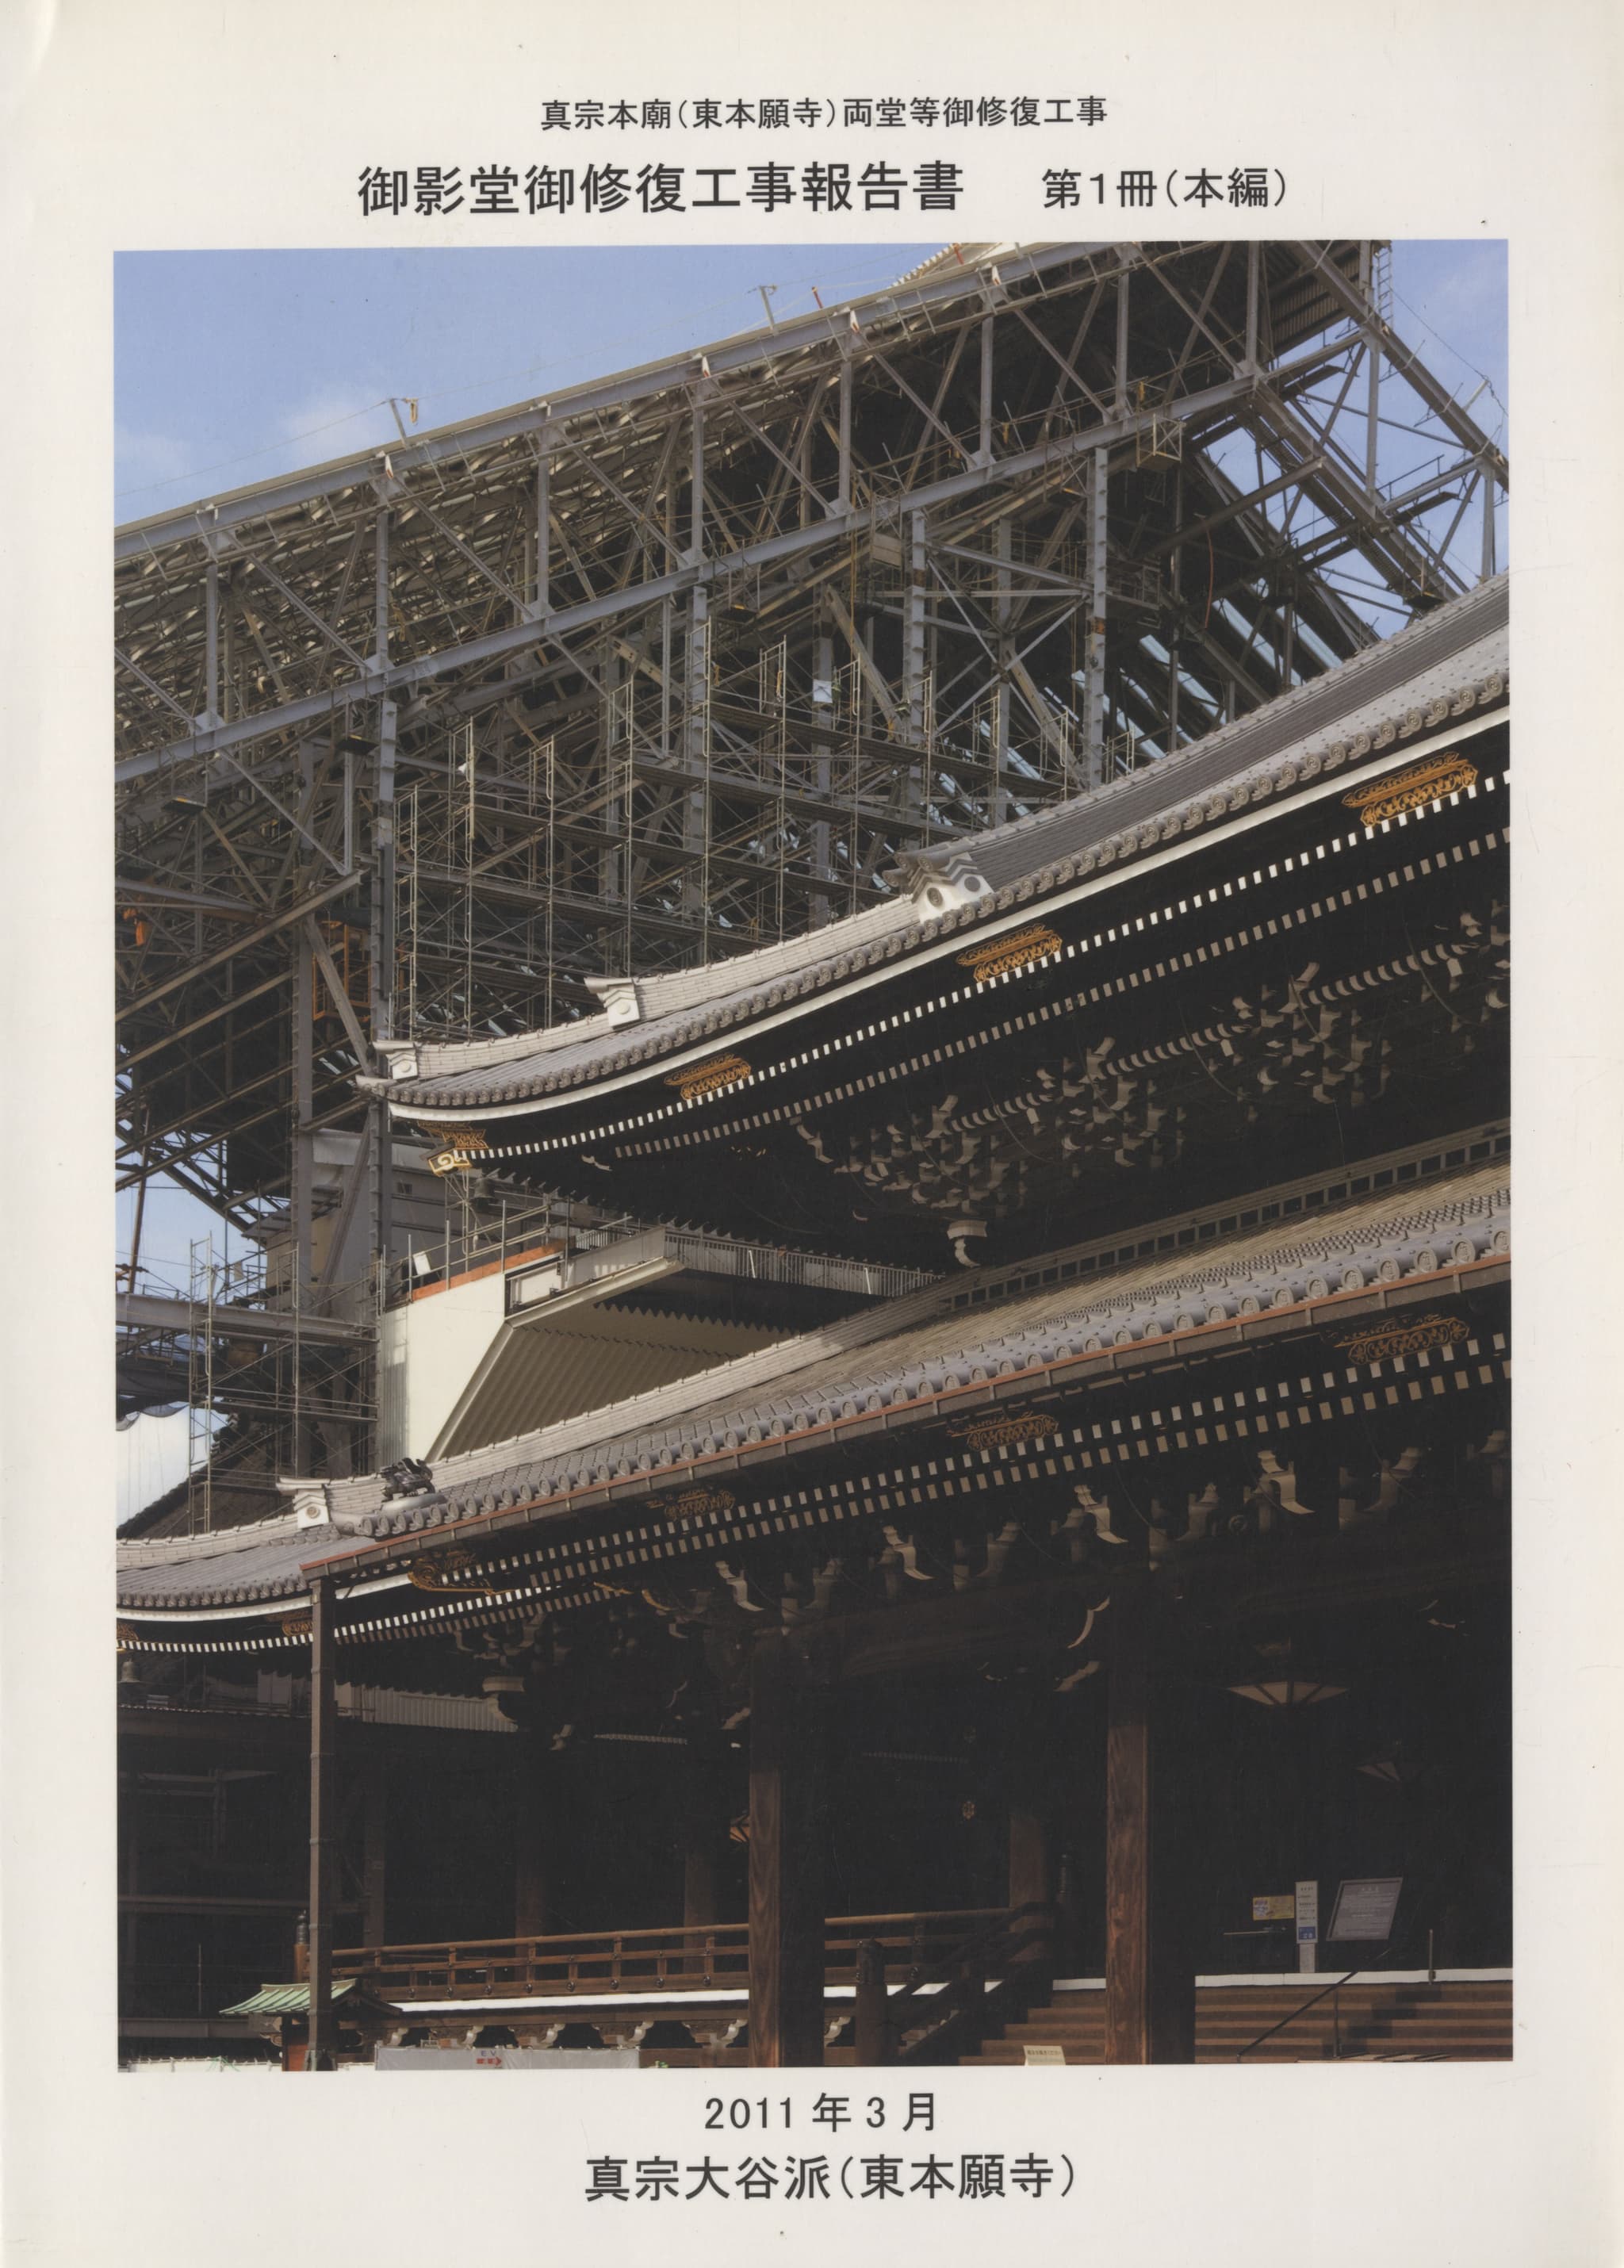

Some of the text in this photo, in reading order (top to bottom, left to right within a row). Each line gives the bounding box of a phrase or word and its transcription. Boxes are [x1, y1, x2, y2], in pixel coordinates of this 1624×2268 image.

[358, 160, 1285, 216] 御影堂御修復工事報告書 第1冊(本編)
[585, 2153, 1073, 2201] 真宗大谷派(東本願寺)
